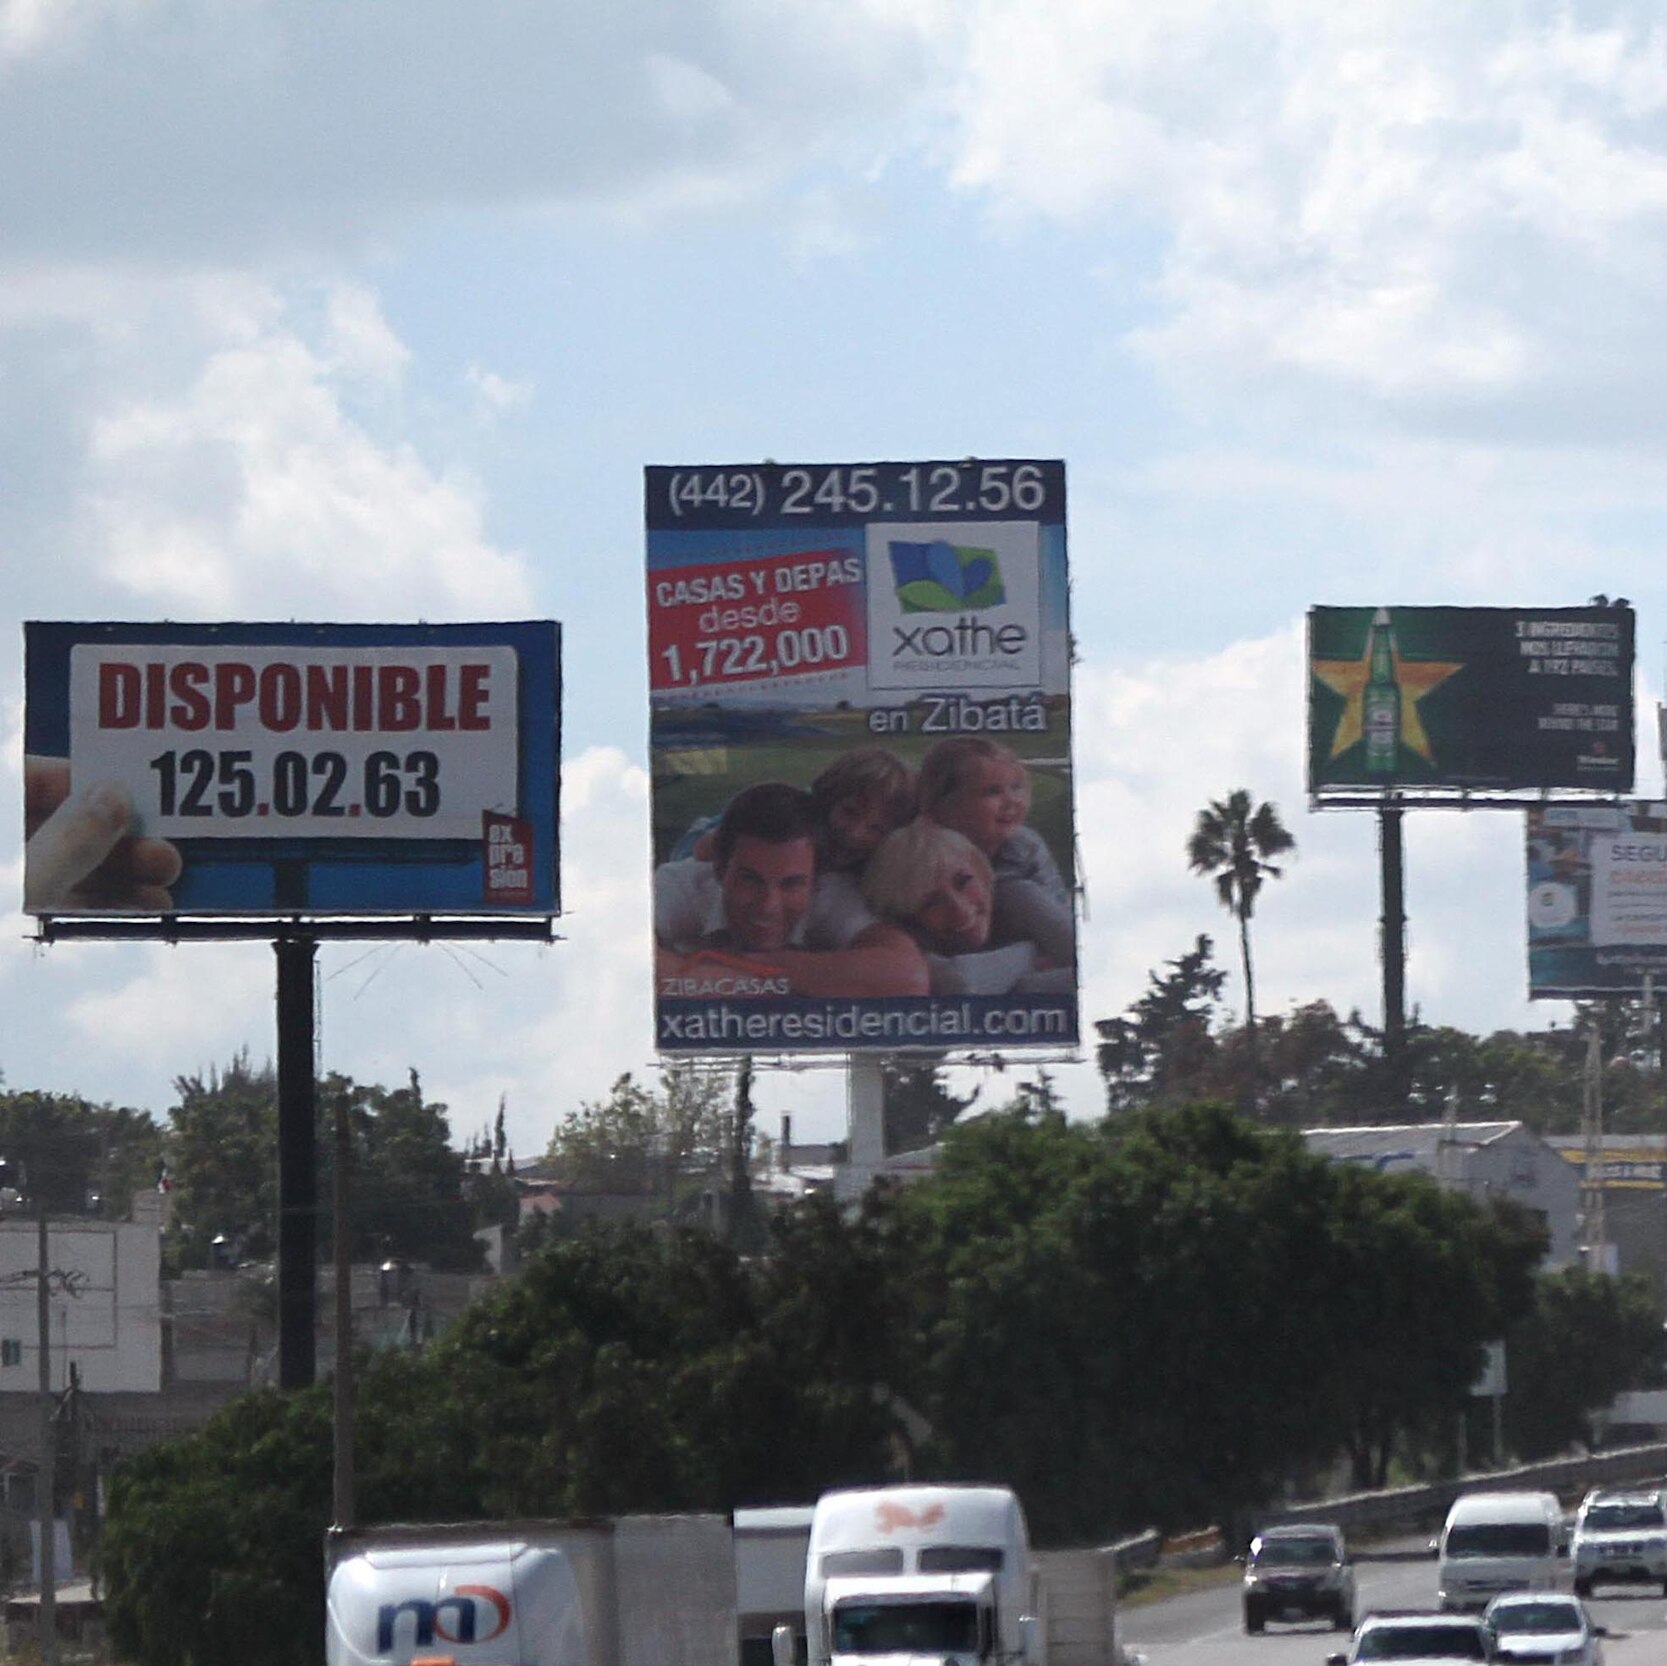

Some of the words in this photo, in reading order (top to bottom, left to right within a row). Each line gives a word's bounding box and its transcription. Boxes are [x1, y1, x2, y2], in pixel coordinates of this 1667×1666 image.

[668, 472, 765, 516] (442)
[780, 465, 1046, 514] 245.12.56
[656, 573, 745, 607] CASAS
[750, 569, 770, 595] Y
[775, 557, 861, 593] DEPAS
[698, 598, 801, 634] desde
[893, 617, 1027, 658] xathe
[662, 625, 848, 685] 1,722,000
[99, 662, 492, 732] DISPONIBLE
[869, 708, 907, 731] en
[921, 693, 1047, 731] Zibatá
[150, 749, 440, 818] 125.02.63
[661, 1004, 1067, 1039] xatheresidencial.com
